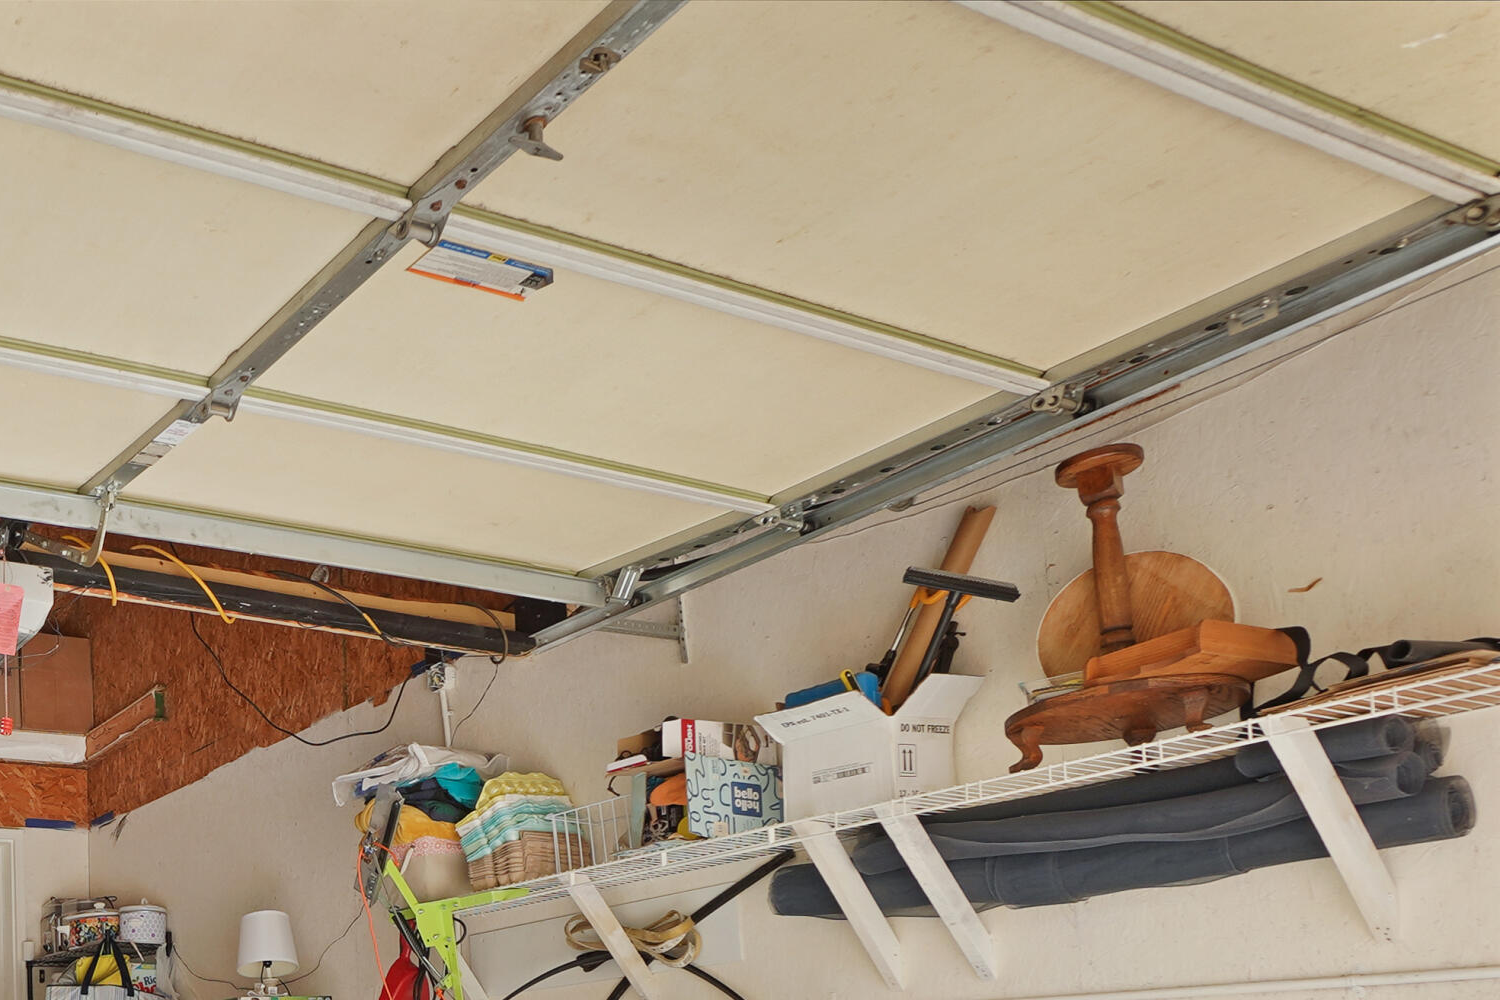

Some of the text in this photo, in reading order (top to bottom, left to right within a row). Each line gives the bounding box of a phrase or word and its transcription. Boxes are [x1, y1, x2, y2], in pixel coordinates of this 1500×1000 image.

[900, 723, 950, 734] DO NOT FREEZE
[734, 786, 760, 800] bello
